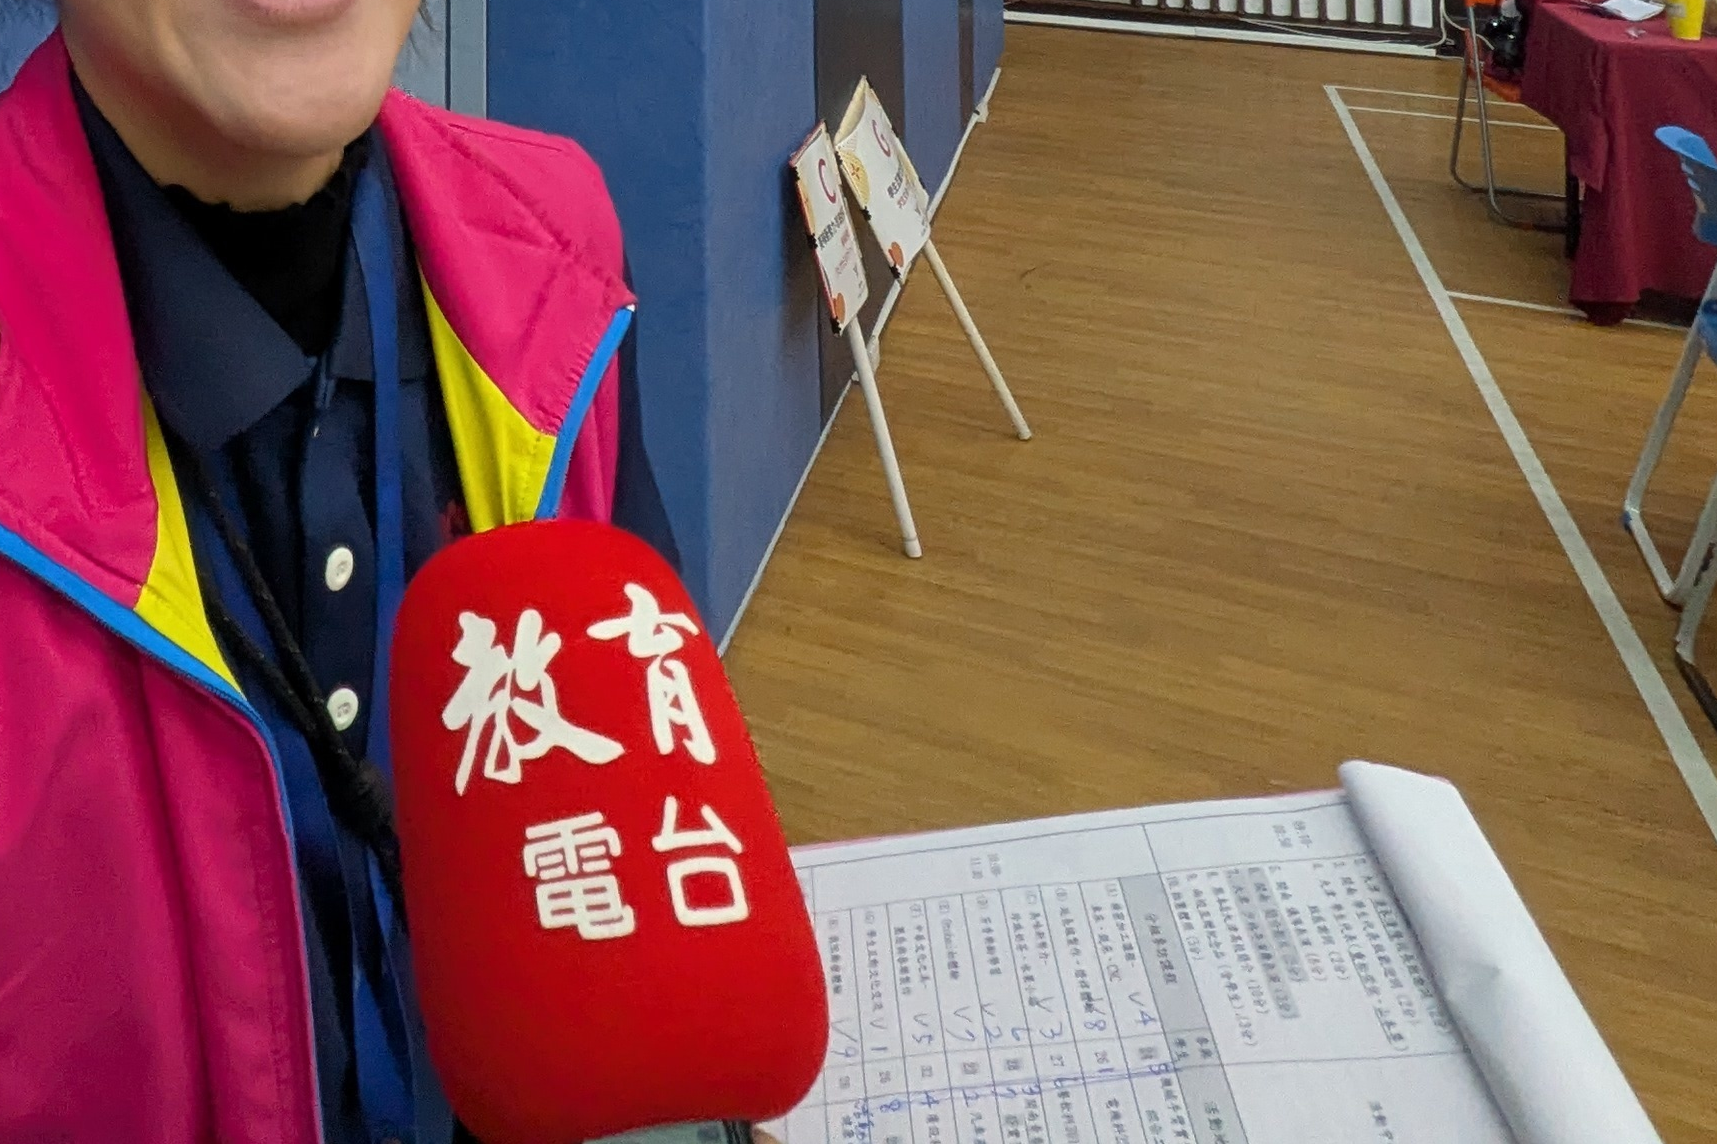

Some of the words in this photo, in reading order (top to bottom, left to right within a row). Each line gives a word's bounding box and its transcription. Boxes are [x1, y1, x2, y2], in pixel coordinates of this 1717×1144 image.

[441, 582, 716, 796] 教育
[522, 795, 750, 941] 電台
[1038, 1020, 1065, 1040] 3
